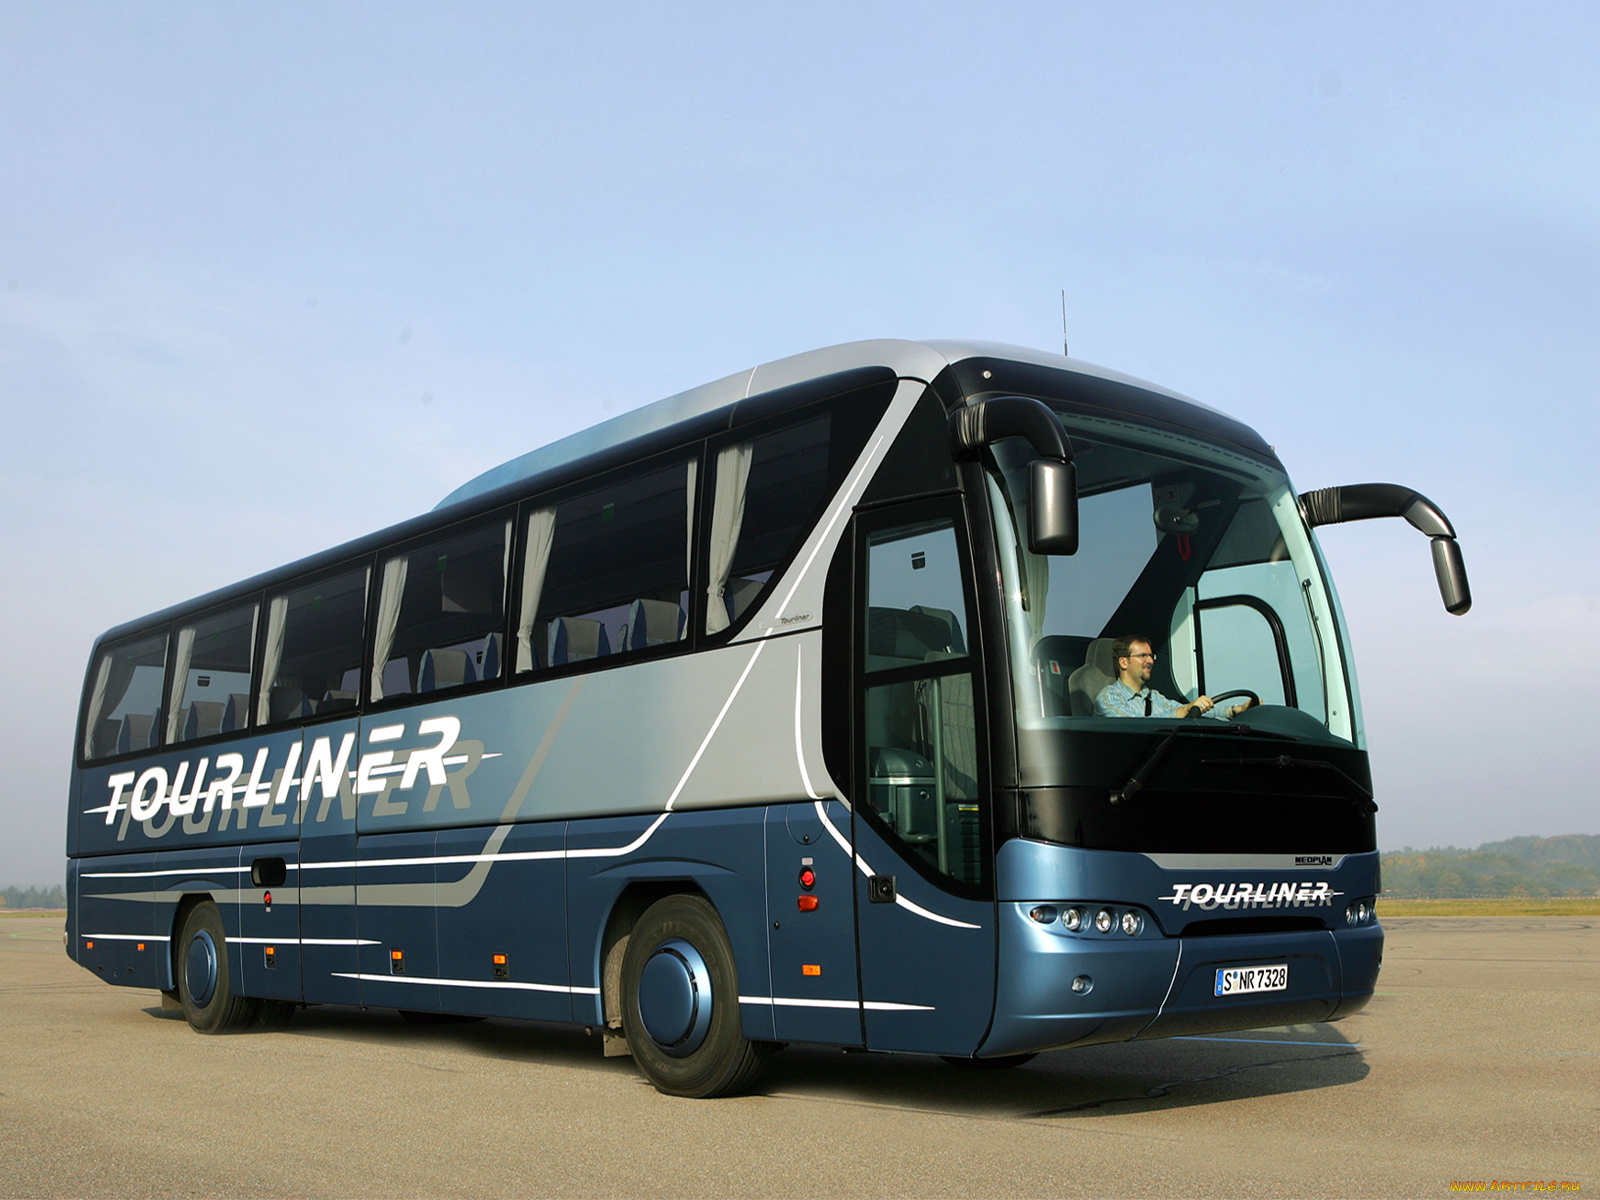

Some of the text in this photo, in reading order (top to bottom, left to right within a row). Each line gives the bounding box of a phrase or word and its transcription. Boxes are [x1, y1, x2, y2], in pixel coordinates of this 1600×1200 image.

[780, 614, 810, 624] Tourliner
[105, 715, 461, 826] TOURLINER
[1295, 856, 1332, 865] NEOPLAN
[1172, 882, 1329, 905] TOURLINER
[1224, 968, 1286, 991] S NR 7328
